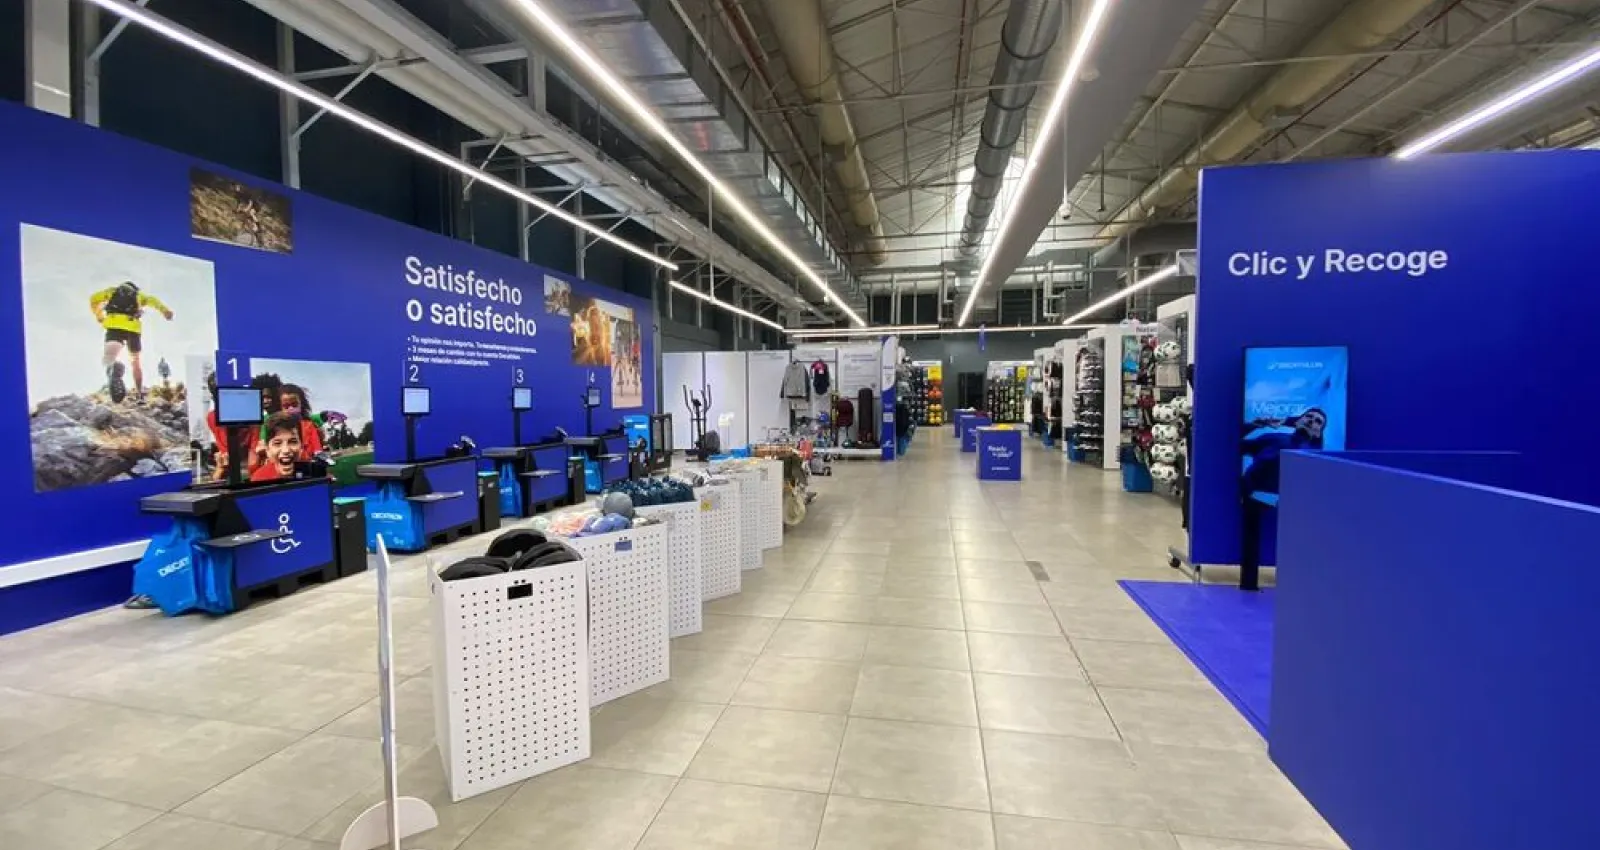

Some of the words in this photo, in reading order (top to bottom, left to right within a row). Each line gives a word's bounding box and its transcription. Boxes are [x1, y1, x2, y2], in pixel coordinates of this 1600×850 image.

[1228, 251, 1287, 276] Clic
[1296, 254, 1315, 280] y
[1324, 248, 1448, 276] Recoge
[405, 256, 522, 305] Satisfecho
[406, 299, 422, 321] o
[430, 302, 537, 336] satisfecho
[227, 357, 238, 381] 1
[410, 364, 419, 382] 2
[516, 368, 524, 384] 3
[590, 371, 596, 383] 4
